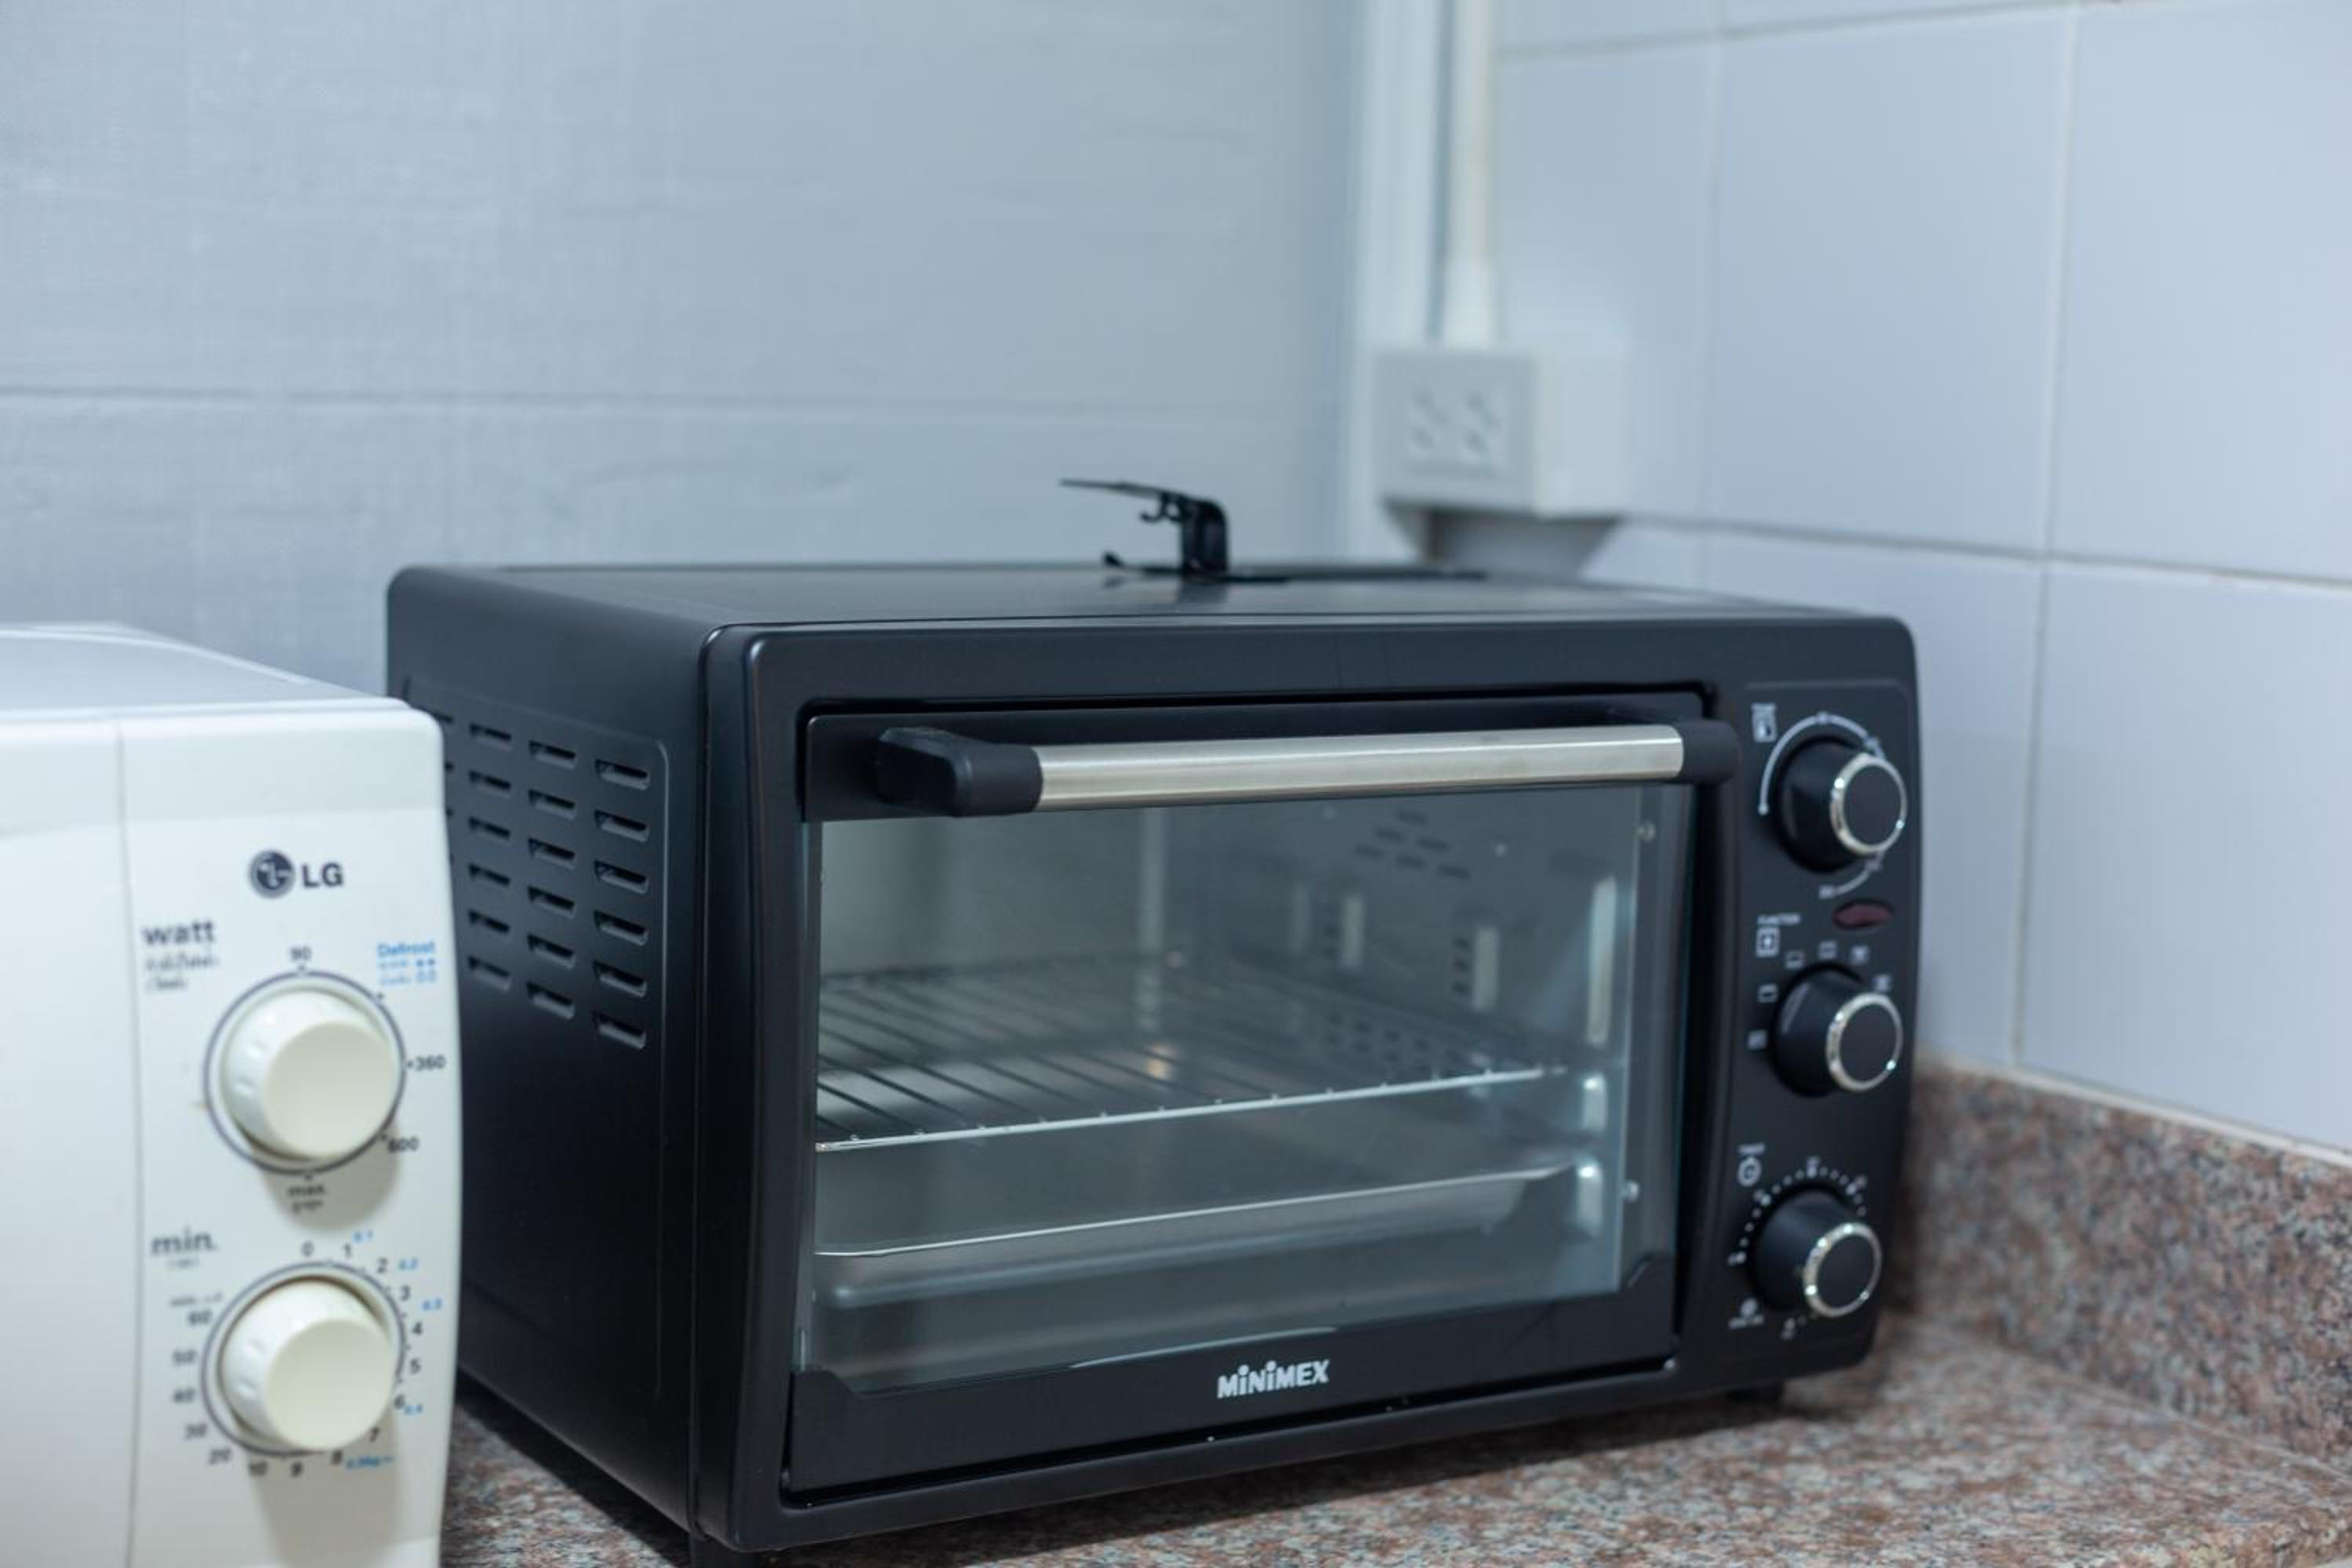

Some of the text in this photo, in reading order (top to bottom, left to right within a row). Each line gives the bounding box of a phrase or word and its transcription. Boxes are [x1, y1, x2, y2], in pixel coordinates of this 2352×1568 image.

[301, 863, 344, 887] LG
[143, 920, 215, 944] watt
[377, 1258, 389, 1273] 2
[400, 1286, 412, 1301] 3
[412, 1322, 423, 1336] 4
[410, 1359, 422, 1374] 5
